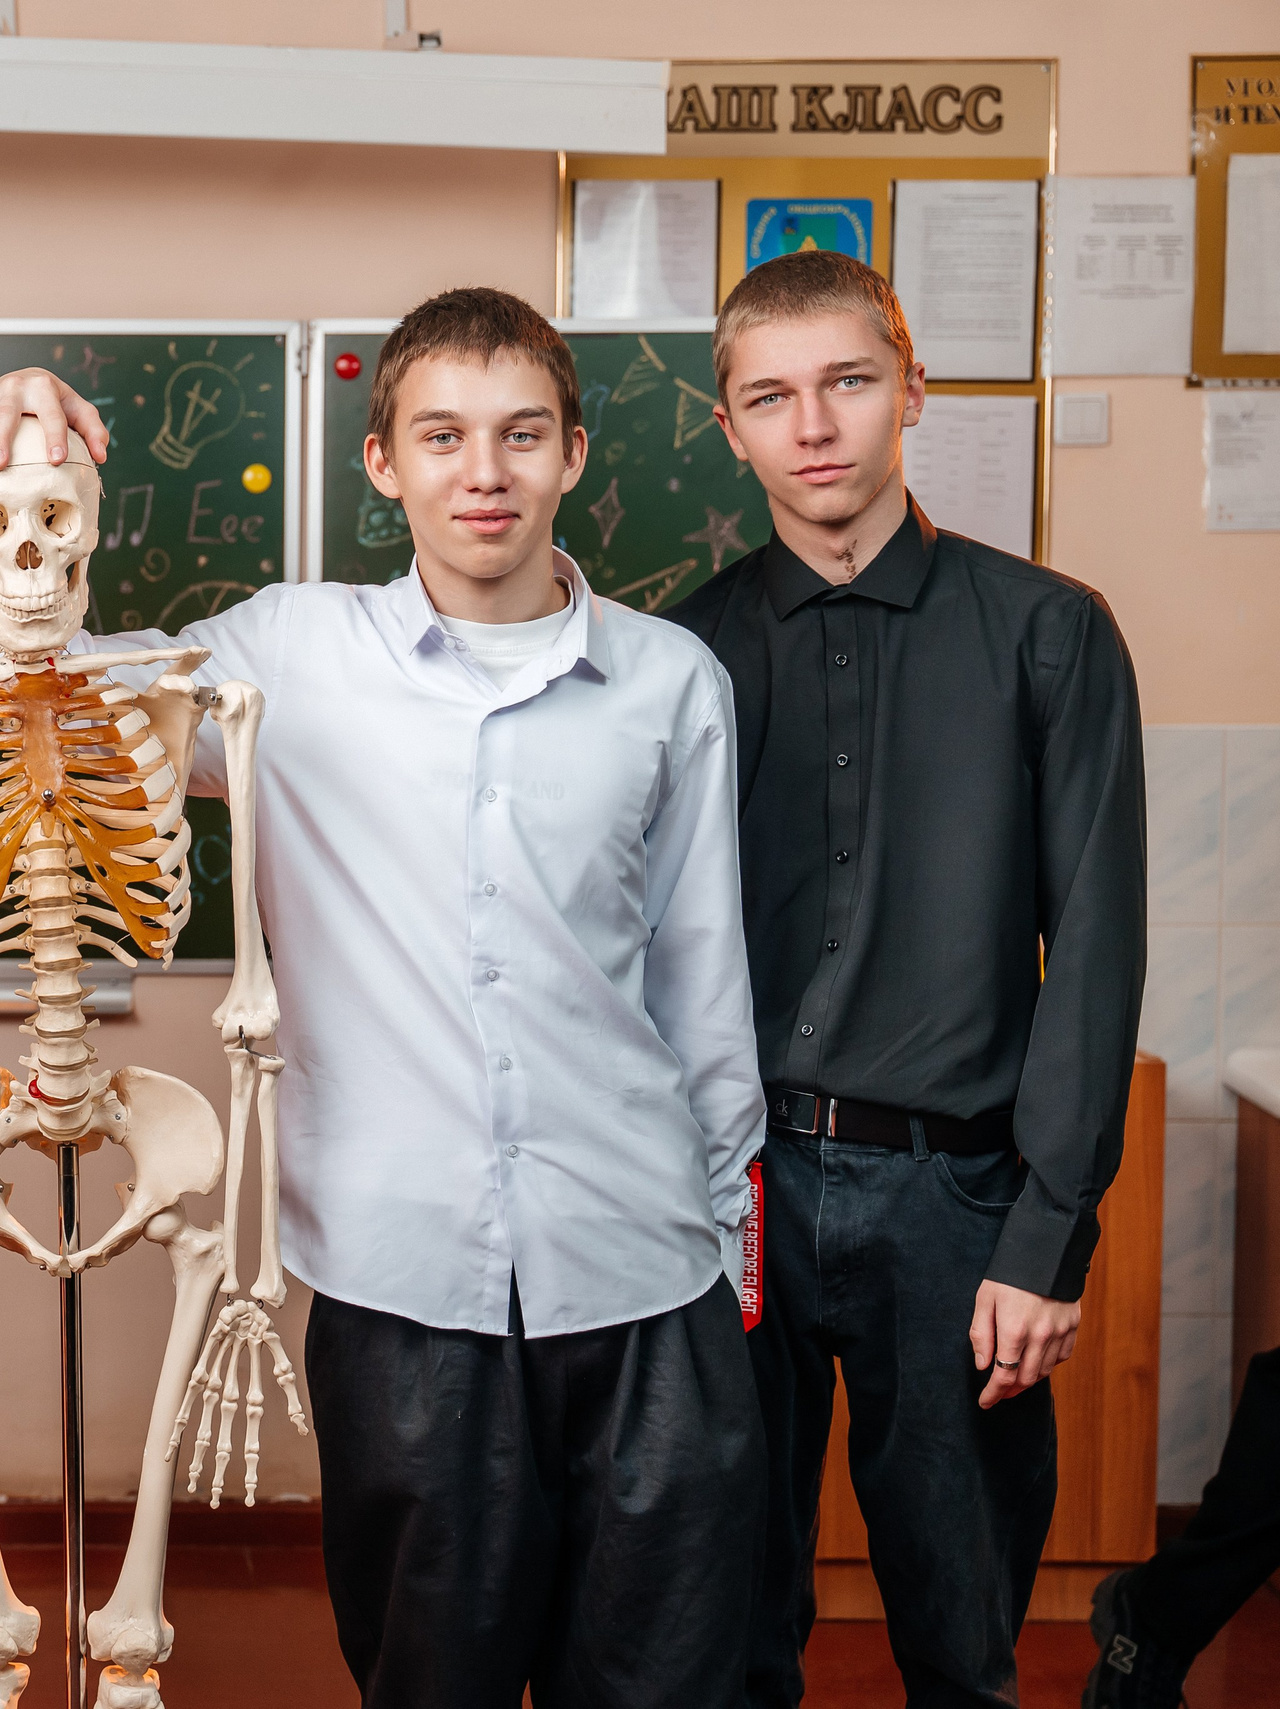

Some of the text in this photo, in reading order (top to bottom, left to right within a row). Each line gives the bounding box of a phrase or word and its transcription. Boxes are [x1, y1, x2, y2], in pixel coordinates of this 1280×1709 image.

[667, 83, 1003, 134] АШ КЛАСС
[742, 1232, 758, 1274] BEFORE
[741, 1276, 757, 1315] FLIGHT
